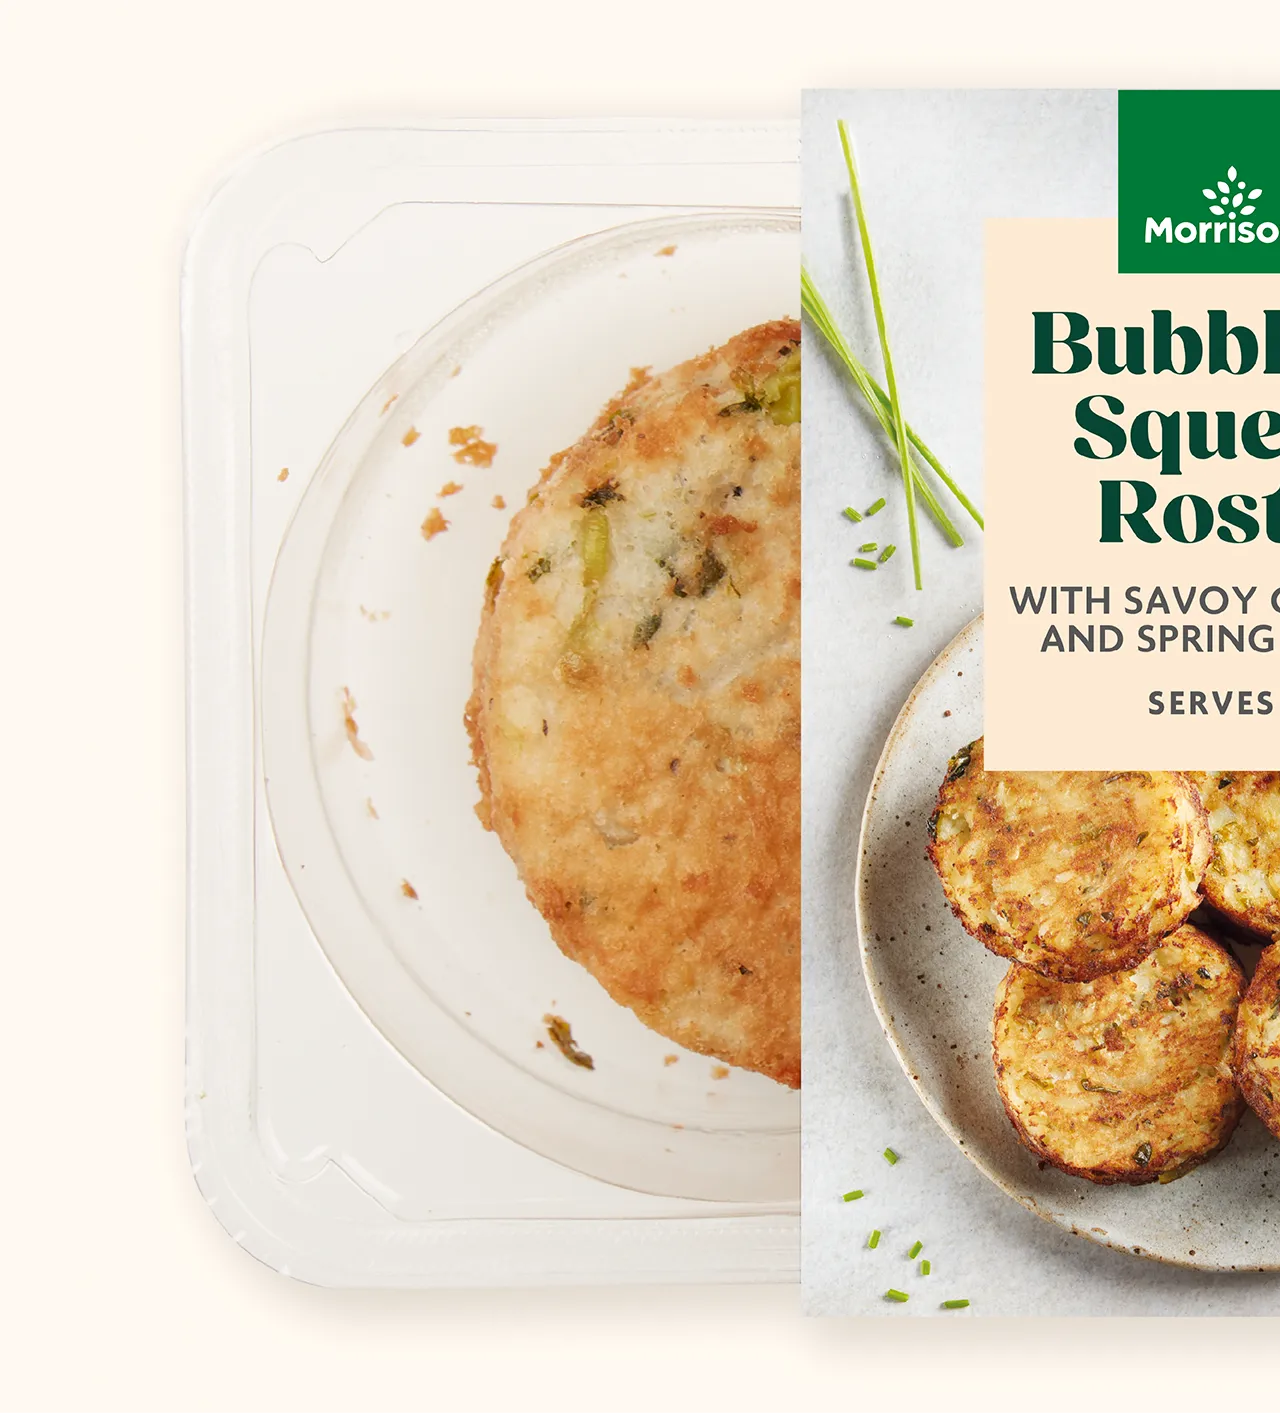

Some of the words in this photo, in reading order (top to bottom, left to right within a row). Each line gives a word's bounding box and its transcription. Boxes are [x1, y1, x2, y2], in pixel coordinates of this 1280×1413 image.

[1010, 587, 1109, 614] WITH
[1125, 586, 1257, 614] SAVOY
[1041, 625, 1123, 652] AND
[1138, 625, 1273, 652] SPRING
[1149, 691, 1273, 715] SERVES
